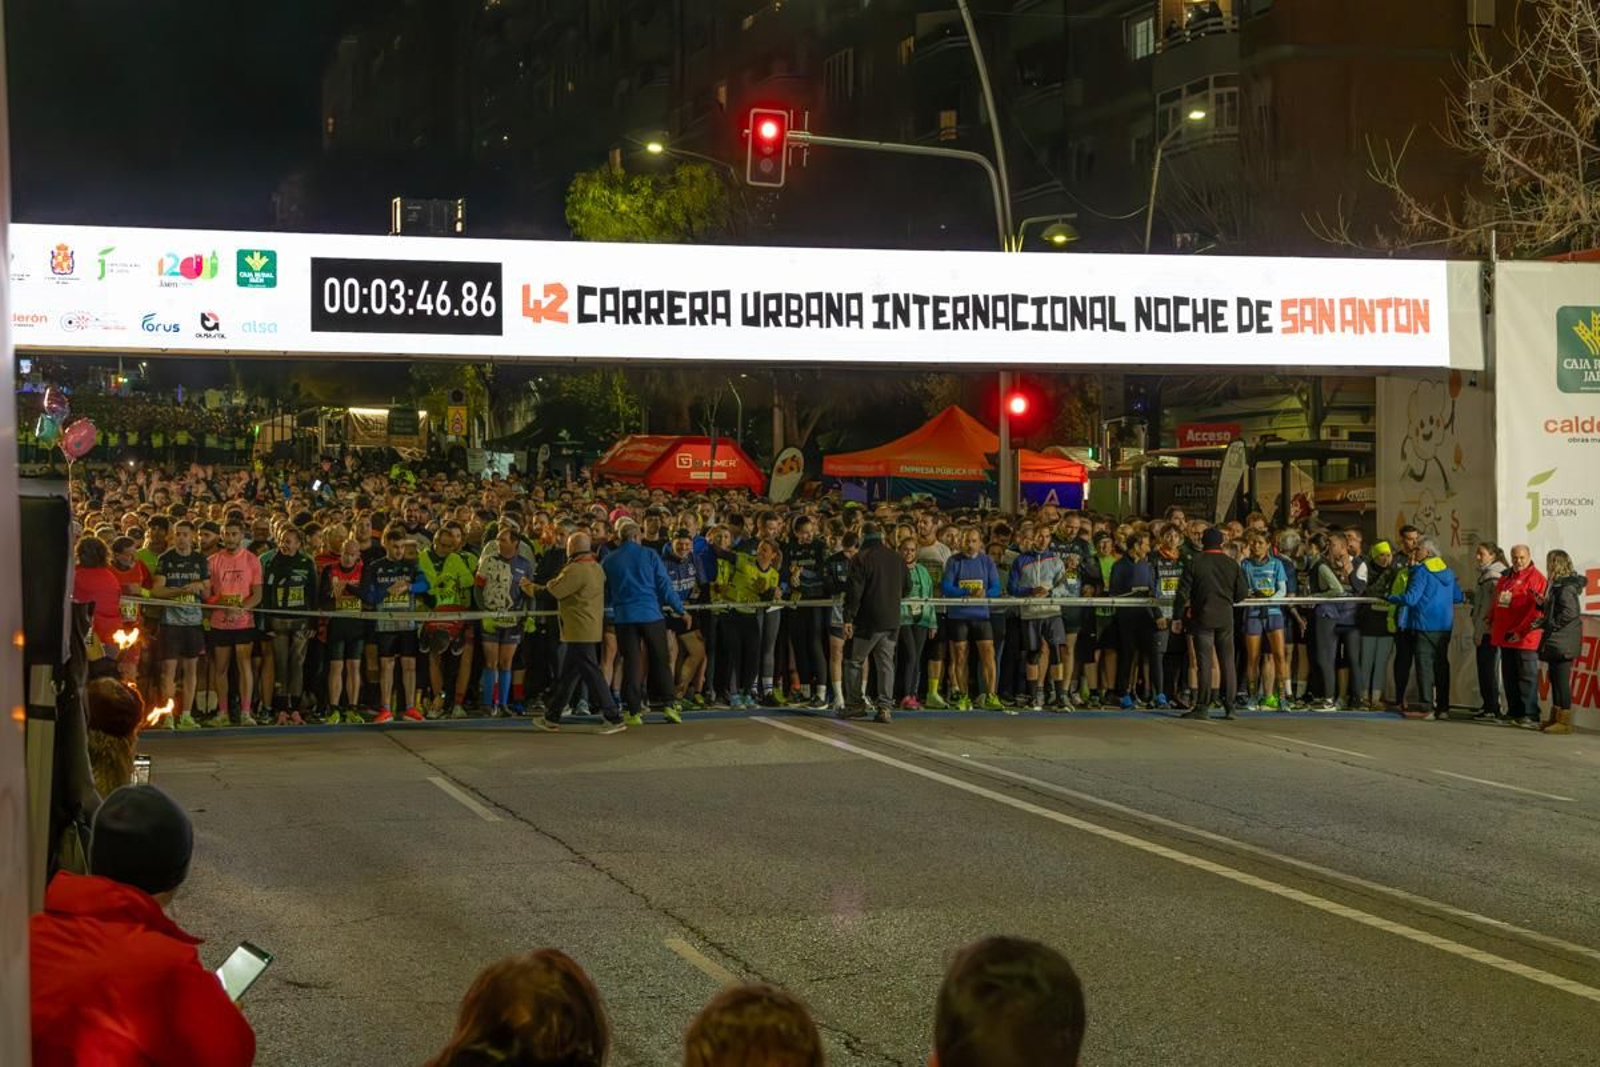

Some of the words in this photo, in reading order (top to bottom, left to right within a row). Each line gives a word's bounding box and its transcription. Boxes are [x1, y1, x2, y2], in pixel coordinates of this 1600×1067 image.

[324, 277, 497, 318] 00:03:46.86
[523, 284, 570, 324] 42
[577, 285, 733, 328] CARRERA
[742, 291, 865, 330] URBANA
[873, 293, 1128, 334] INTERNACIONAL
[1135, 296, 1230, 335] NOCHE
[1237, 297, 1274, 335] DE
[1281, 297, 1336, 335] SAN
[241, 320, 278, 334] alsa
[1544, 415, 1600, 434] cald
[1186, 429, 1231, 442] Acceso
[900, 465, 934, 474] EMPRESA
[1542, 497, 1594, 506] DIPUTACIÓN
[1542, 509, 1553, 517] DE
